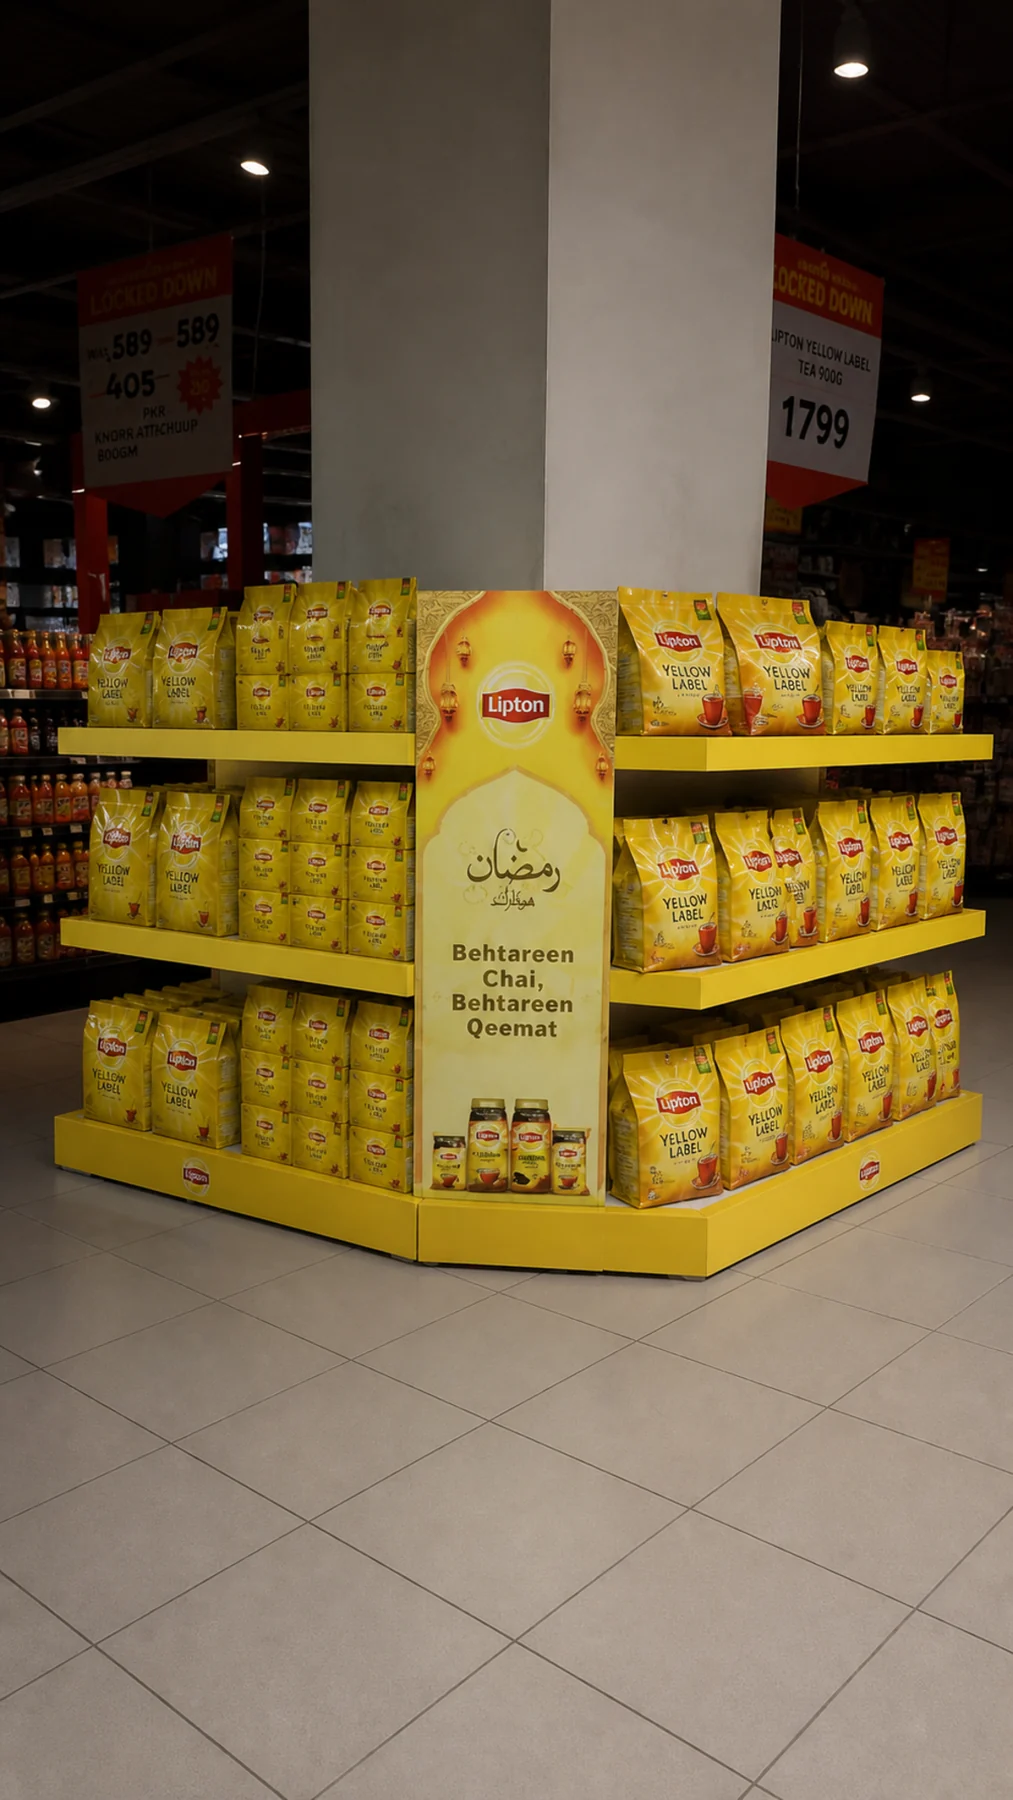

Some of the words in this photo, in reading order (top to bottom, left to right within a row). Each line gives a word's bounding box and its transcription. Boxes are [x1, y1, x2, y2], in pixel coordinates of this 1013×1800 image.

[90, 280, 158, 317] LOCKED
[162, 264, 218, 299] DOWN
[829, 286, 874, 327] DOWN
[113, 329, 152, 359] 589
[177, 313, 219, 347] 589
[806, 338, 843, 363] YELLOW
[844, 351, 871, 373] LABEL
[798, 358, 817, 378] TEA
[818, 366, 843, 386] 900G
[107, 370, 155, 399] 405
[143, 404, 166, 420] PKR
[782, 395, 850, 450] 1799
[95, 428, 134, 445] KNORR
[658, 633, 698, 648] Lipton
[662, 664, 711, 678] YELLOW
[762, 666, 811, 679] YELLOW
[672, 679, 708, 691] LABEL
[773, 679, 807, 692] LABEL
[488, 696, 545, 717] Lipton
[467, 828, 561, 893] رمضان
[663, 893, 707, 909] YELLOW
[672, 909, 704, 923] LABEL
[452, 943, 574, 963] Behtareen
[483, 970, 543, 991] Chai,
[452, 994, 573, 1013] Behtareen
[466, 1018, 557, 1039] Qeemat
[806, 1052, 831, 1071] Lipton
[162, 1081, 197, 1099] YELLOW
[745, 1075, 774, 1092] Lipton
[166, 1095, 192, 1110] LABEL
[660, 1096, 698, 1112] Lipton
[748, 1104, 784, 1126] YELLOW
[659, 1127, 708, 1146] YELLOW
[669, 1143, 702, 1159] LABEL
